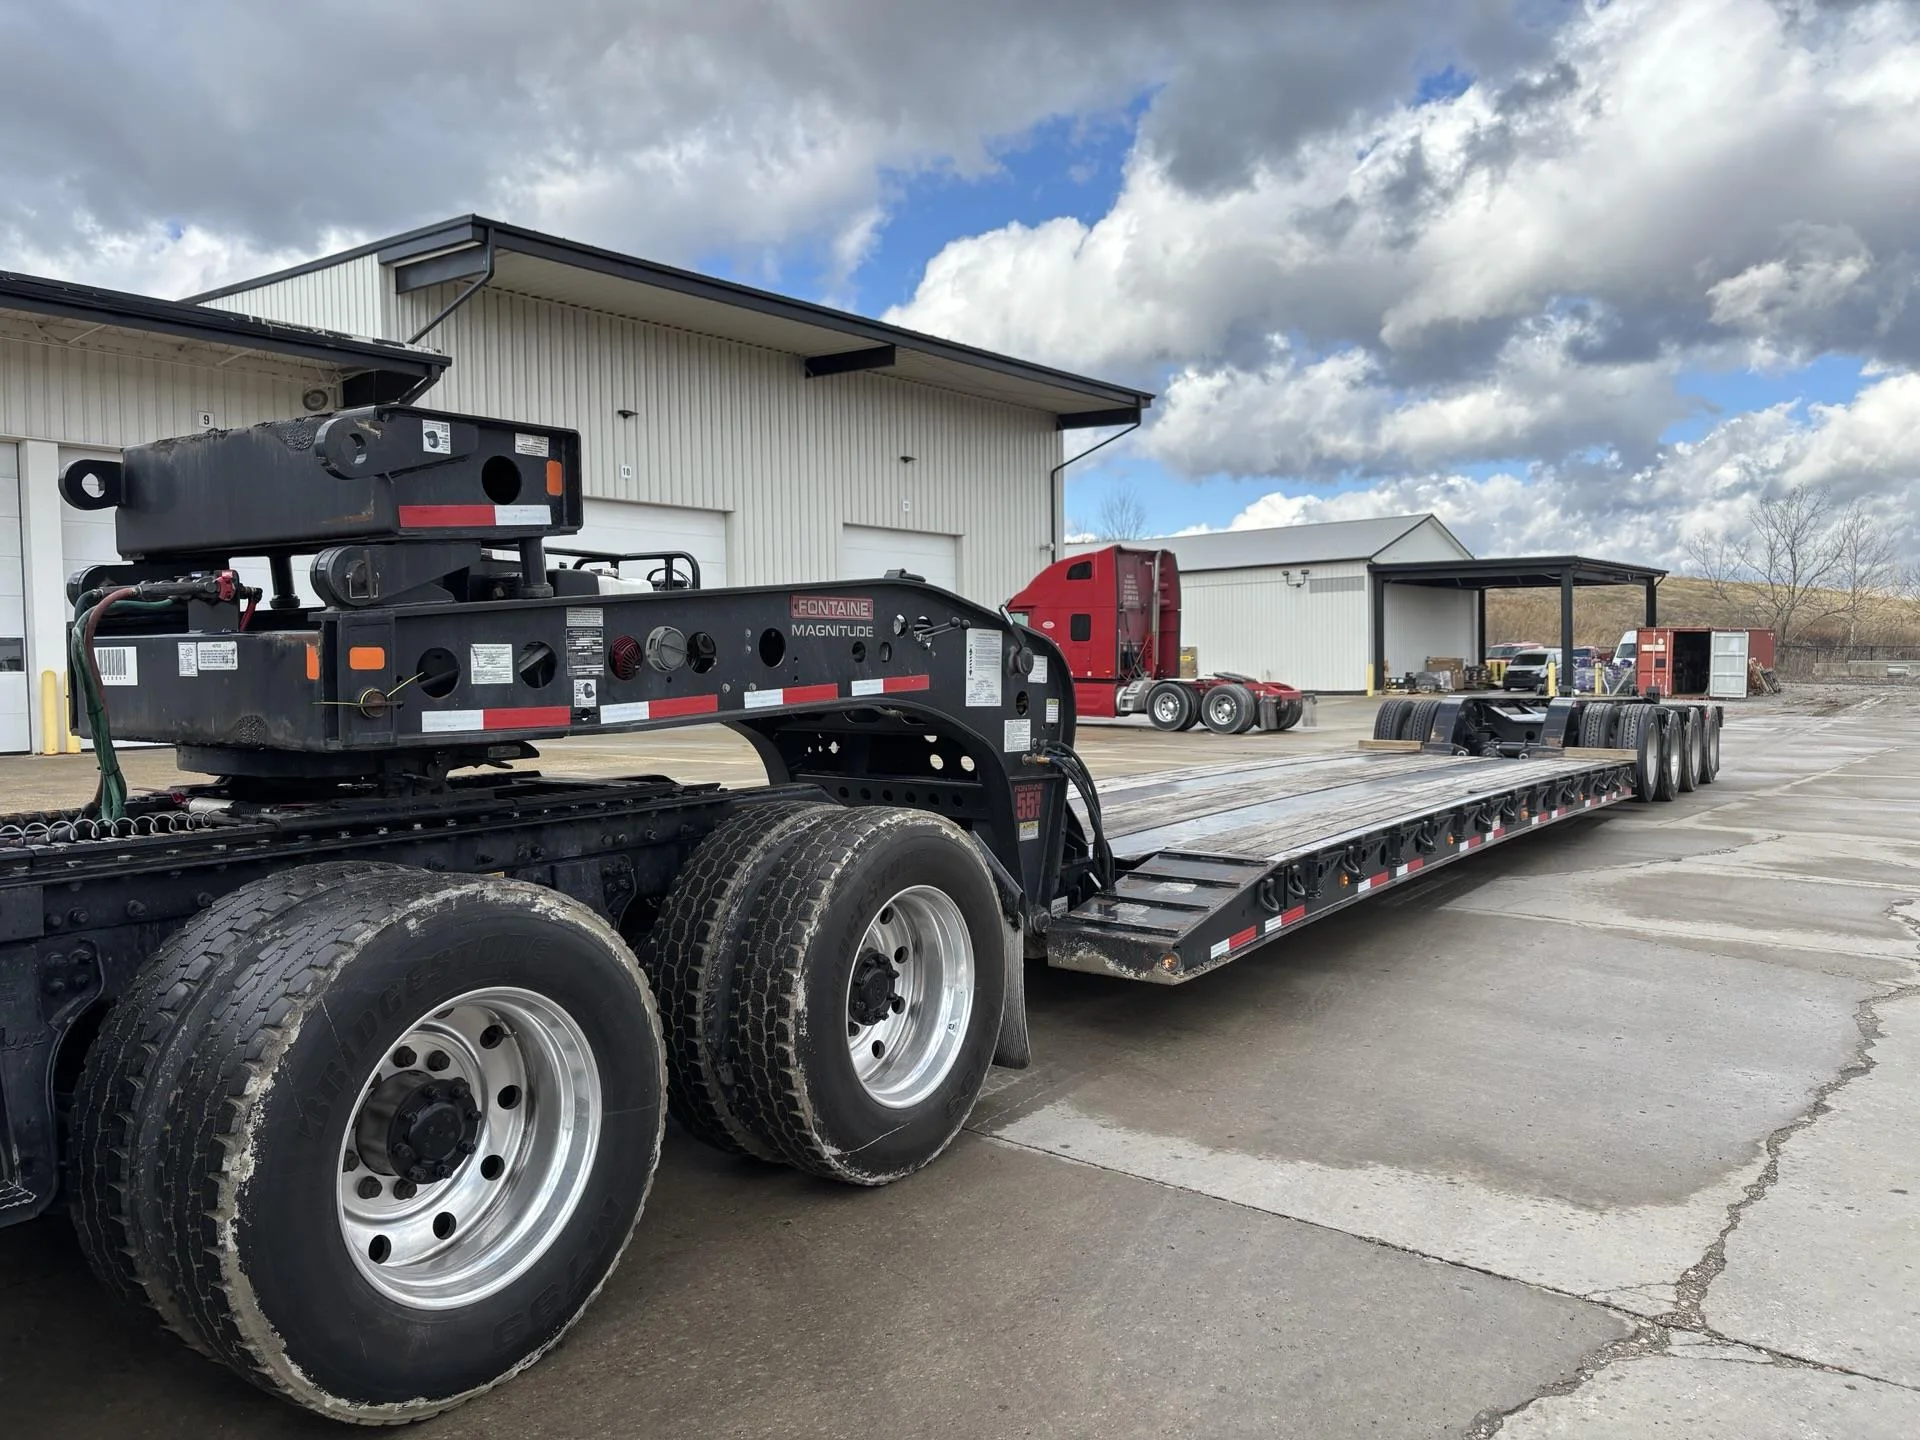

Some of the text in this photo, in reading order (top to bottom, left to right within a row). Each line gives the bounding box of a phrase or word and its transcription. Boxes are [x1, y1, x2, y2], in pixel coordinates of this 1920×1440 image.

[203, 414, 210, 425] 9
[798, 600, 869, 616] FONTAINE
[791, 624, 874, 637] MAGNITUDE
